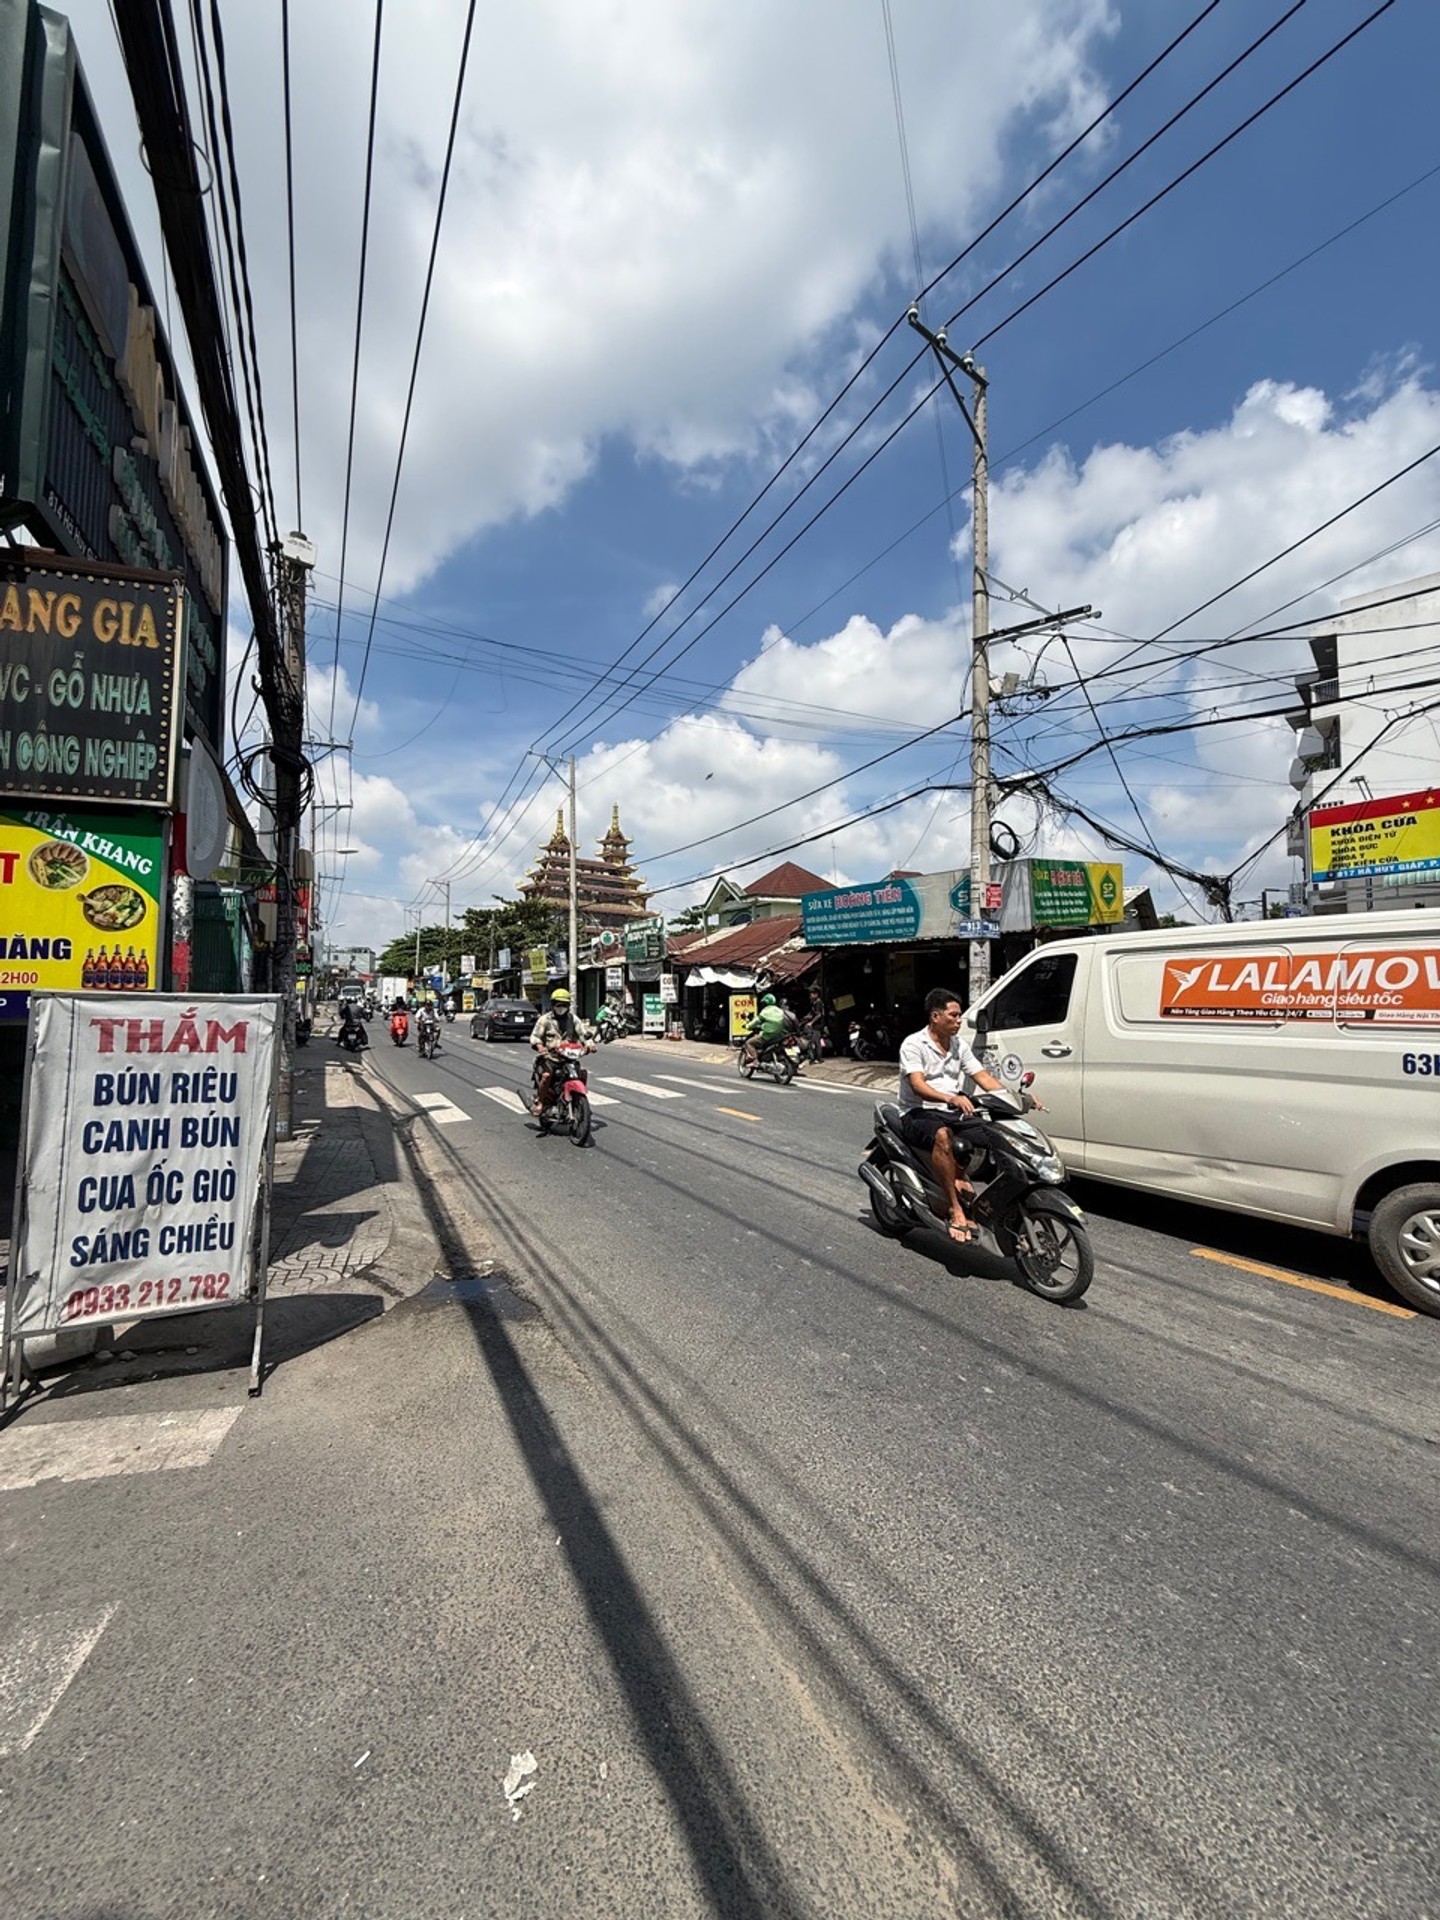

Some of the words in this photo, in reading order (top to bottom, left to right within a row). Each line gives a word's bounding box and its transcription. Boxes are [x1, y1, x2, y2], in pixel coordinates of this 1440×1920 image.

[92, 599, 161, 649] GIA
[48, 651, 85, 709] GỖ
[90, 672, 152, 725] NHỰA
[16, 720, 80, 775] CÔNG
[84, 729, 157, 792] NGHIỆP
[23, 811, 80, 844] TRẦN
[82, 831, 154, 875] KHANG
[1374, 864, 1395, 874] HUY
[1261, 991, 1295, 1005] Giao
[1295, 991, 1335, 1008] hàng
[1336, 991, 1370, 1005] siêu
[1370, 987, 1404, 1005] tốc
[90, 1007, 249, 1055] THẮM
[93, 1065, 160, 1107] BÚN
[171, 1065, 237, 1105] RIÊU
[83, 1116, 169, 1155] CANH
[180, 1109, 240, 1149] BÚN
[78, 1174, 135, 1213] CUA
[146, 1158, 183, 1206] ỐC
[192, 1160, 236, 1203] GIÒ
[70, 1223, 149, 1267] SÁNG
[158, 1212, 235, 1256] CHIỀU
[68, 1272, 230, 1321] 0933.212.782
